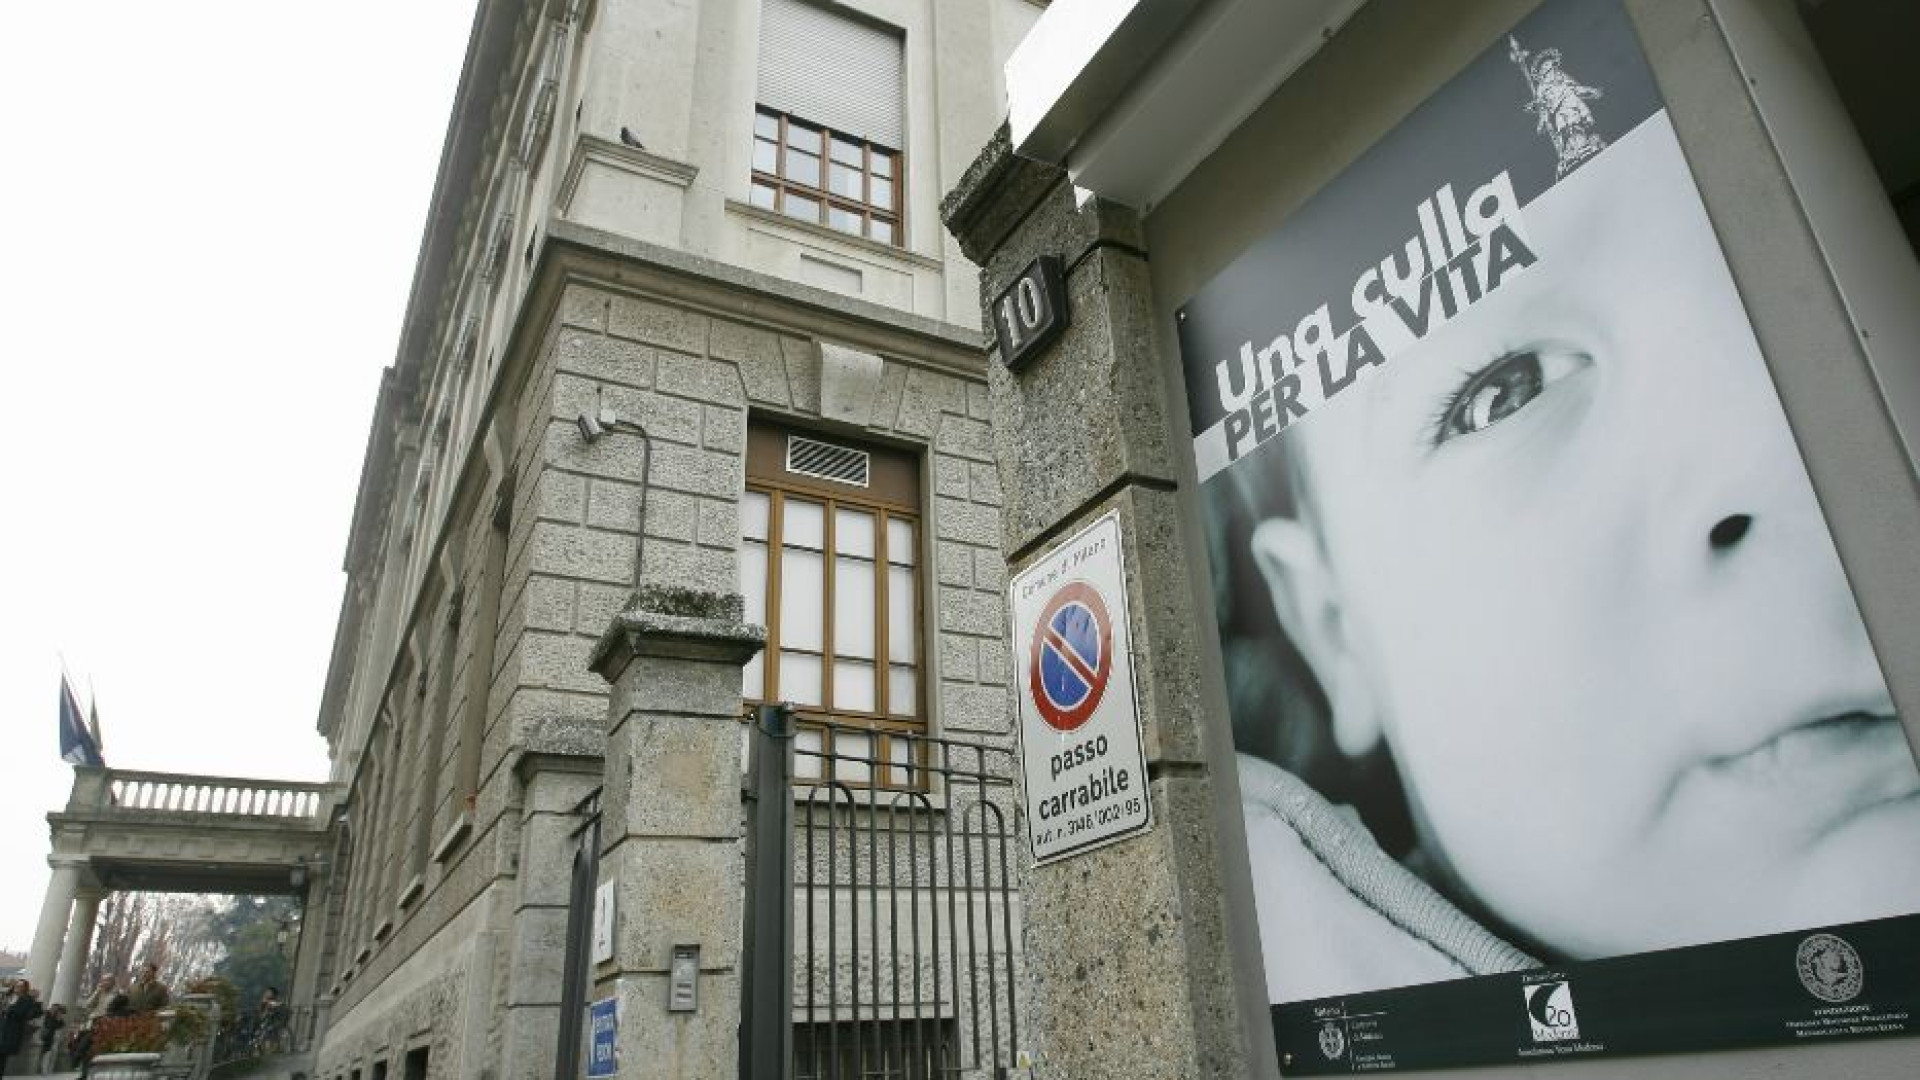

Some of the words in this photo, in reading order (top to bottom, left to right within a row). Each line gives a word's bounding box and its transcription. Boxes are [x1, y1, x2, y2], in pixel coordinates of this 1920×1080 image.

[1002, 277, 1039, 348] 10
[1216, 302, 1337, 413] Una
[1352, 170, 1522, 321] culla
[1224, 373, 1309, 461] PER
[1316, 323, 1387, 400] LA
[1390, 223, 1538, 339] VITA
[1039, 764, 1129, 820] carrabile
[1051, 734, 1108, 782] passo
